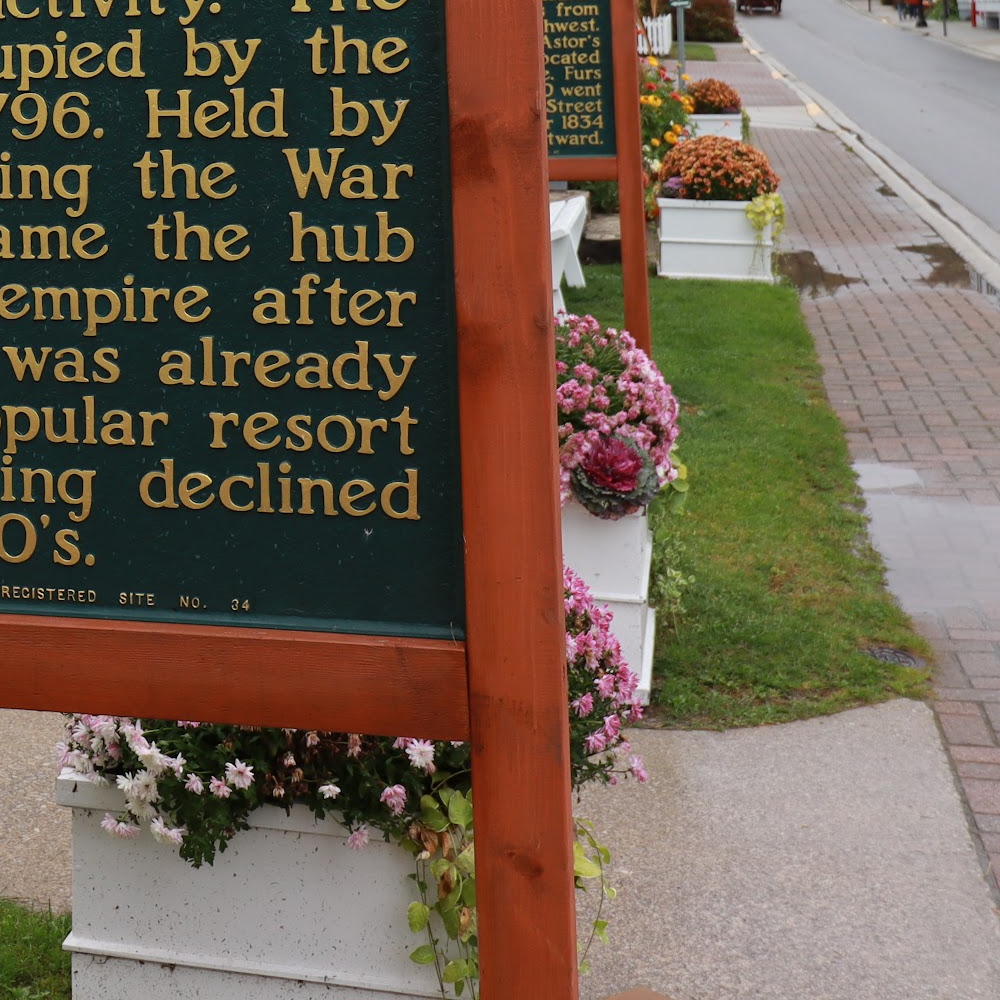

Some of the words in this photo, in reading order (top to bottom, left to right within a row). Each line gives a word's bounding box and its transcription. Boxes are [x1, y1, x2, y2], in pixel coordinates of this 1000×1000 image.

[556, 2, 600, 17] from
[184, 28, 261, 85] by
[304, 26, 409, 74] the
[543, 34, 601, 49] Astor's
[561, 83, 602, 97] went
[564, 66, 602, 81] Furs
[145, 88, 288, 138] Held
[330, 87, 409, 146] by
[546, 99, 603, 113] Street
[562, 114, 604, 129] 1834
[134, 150, 237, 199] the
[282, 148, 413, 199] War
[147, 211, 250, 261] the
[289, 212, 414, 262] hub
[253, 274, 416, 326] after
[2, 346, 120, 383] was
[159, 337, 417, 400] already
[209, 407, 418, 454] resort
[140, 459, 420, 520] declined
[1, 585, 97, 603] REGISTERED
[119, 592, 155, 606] SITE
[179, 595, 207, 609] NO.
[231, 598, 250, 612] 34
